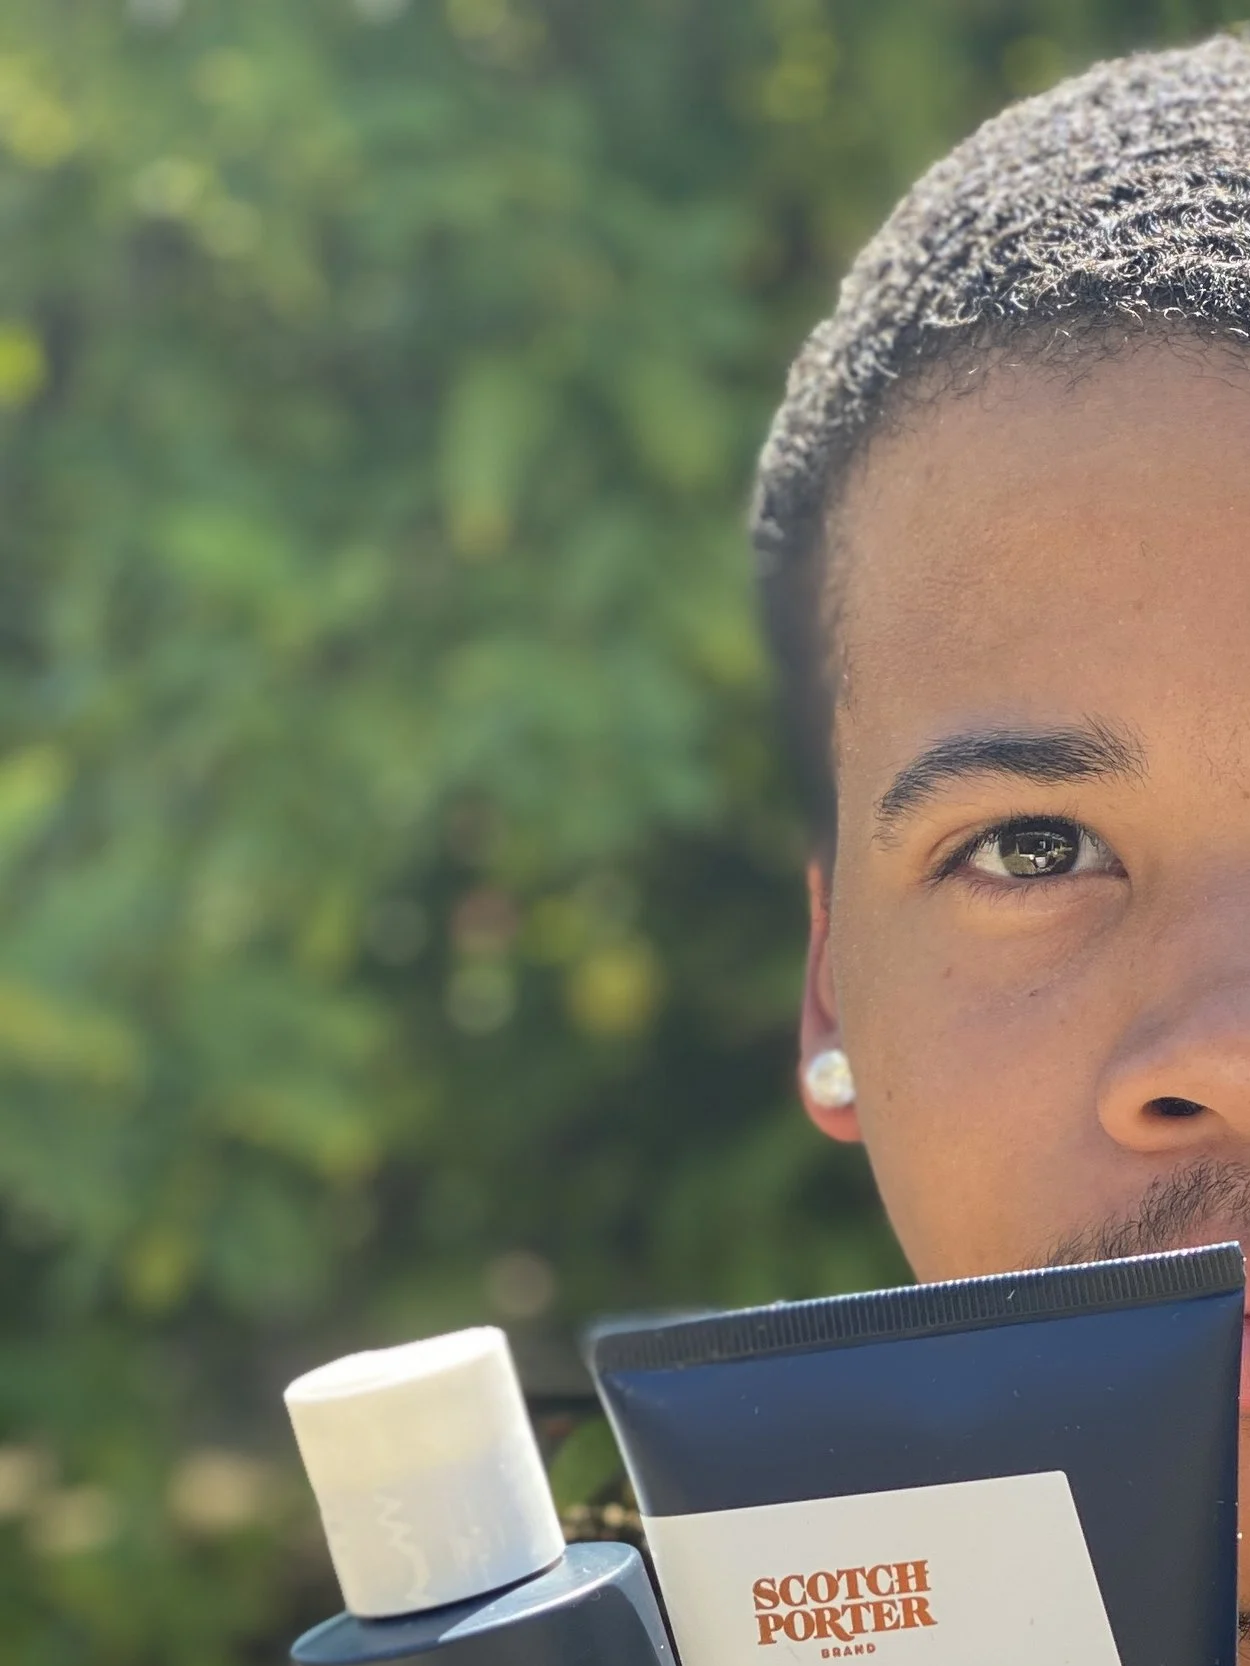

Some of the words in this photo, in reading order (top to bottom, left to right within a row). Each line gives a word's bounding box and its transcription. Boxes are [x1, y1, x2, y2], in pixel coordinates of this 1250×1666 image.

[752, 1559, 931, 1610] SCOTCH
[755, 1596, 938, 1645] PORTER
[821, 1643, 876, 1659] BRAND
